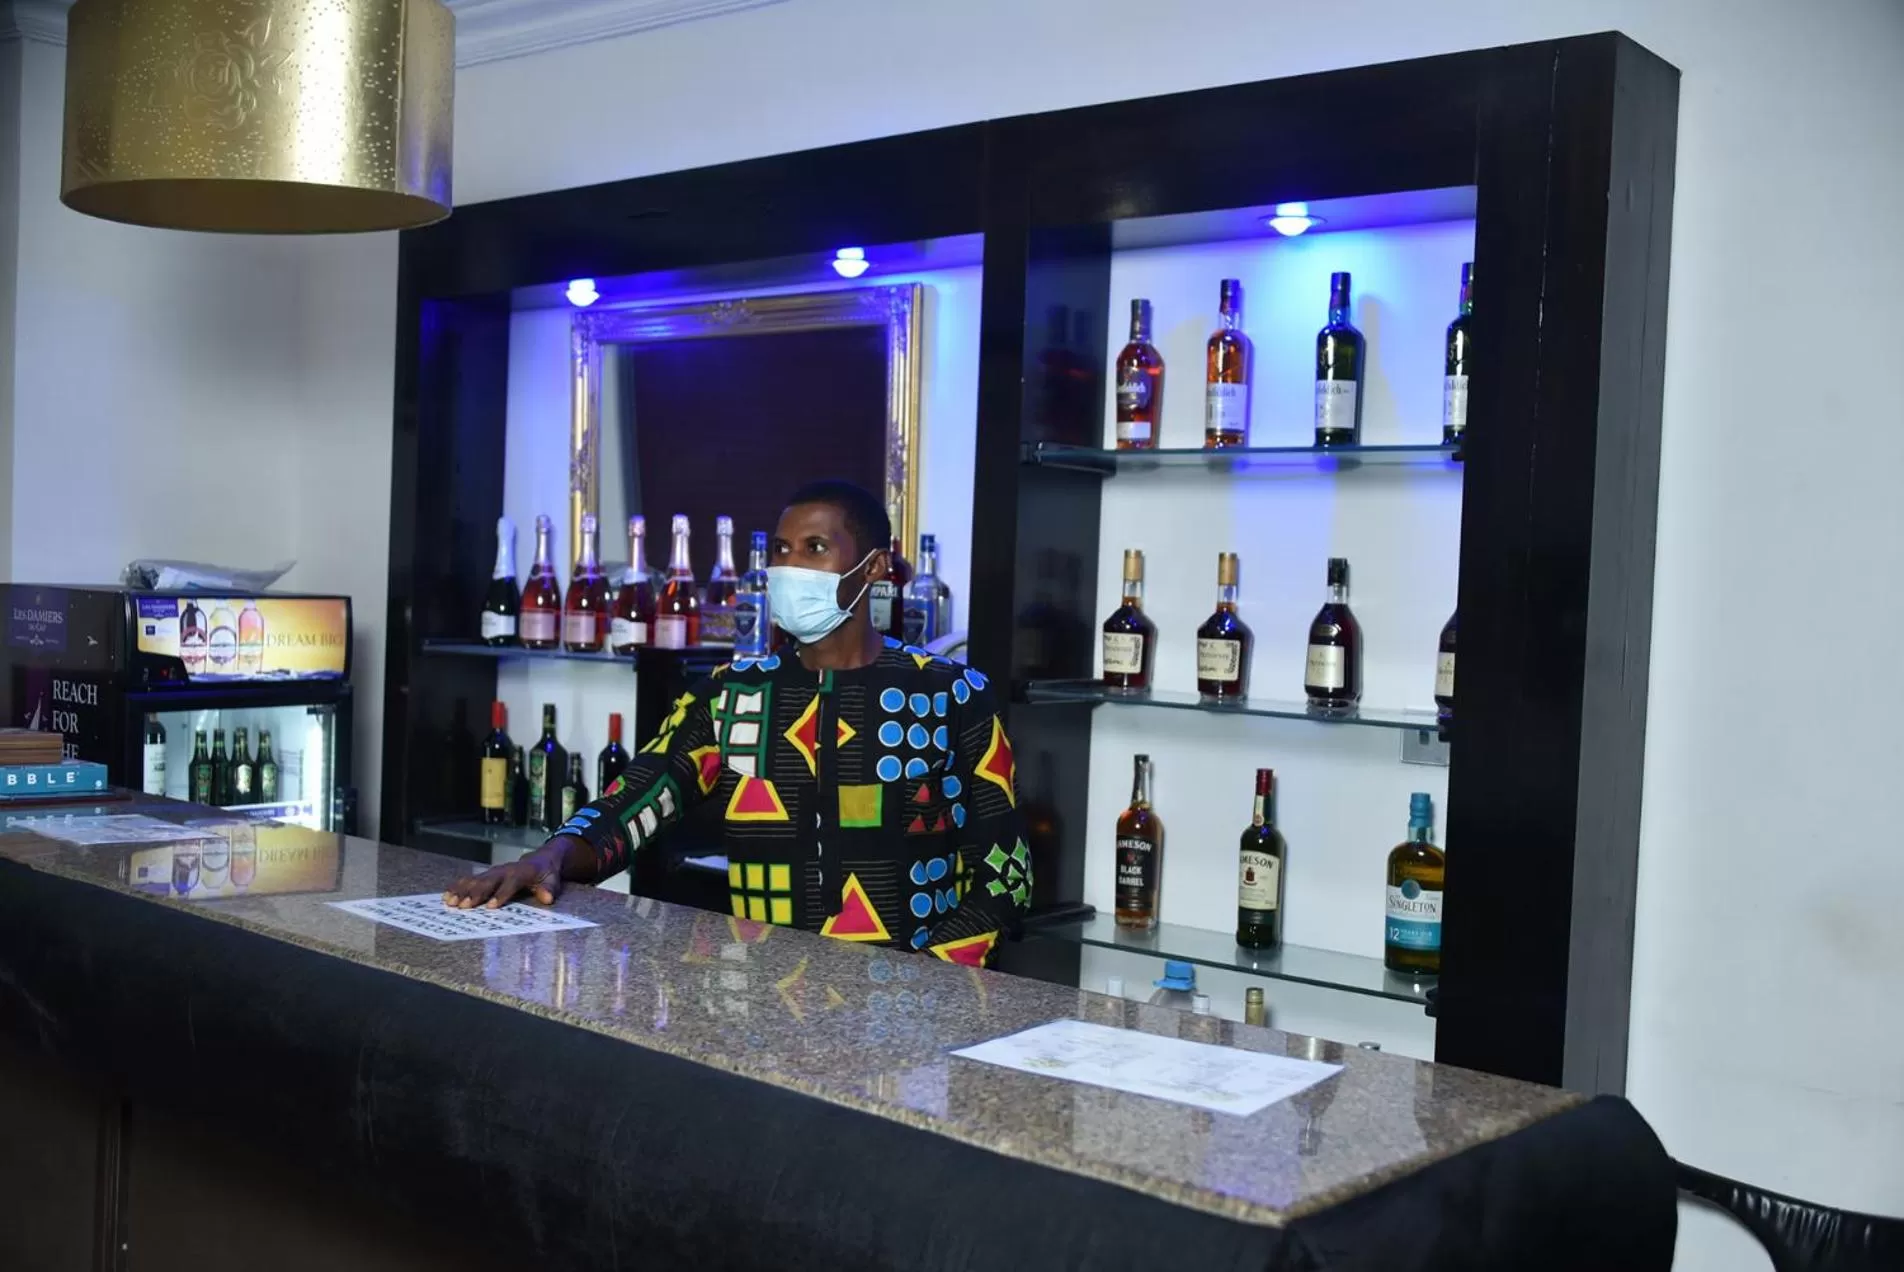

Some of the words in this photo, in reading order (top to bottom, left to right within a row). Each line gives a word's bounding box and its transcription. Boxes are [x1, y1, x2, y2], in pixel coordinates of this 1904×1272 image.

[27, 609, 64, 624] DAMIERS
[266, 633, 316, 647] DREAM
[52, 679, 98, 706] REACH
[52, 710, 79, 733] FOR
[61, 743, 79, 760] HE
[1389, 895, 1436, 912] SINGLETON
[1390, 926, 1400, 941] 12
